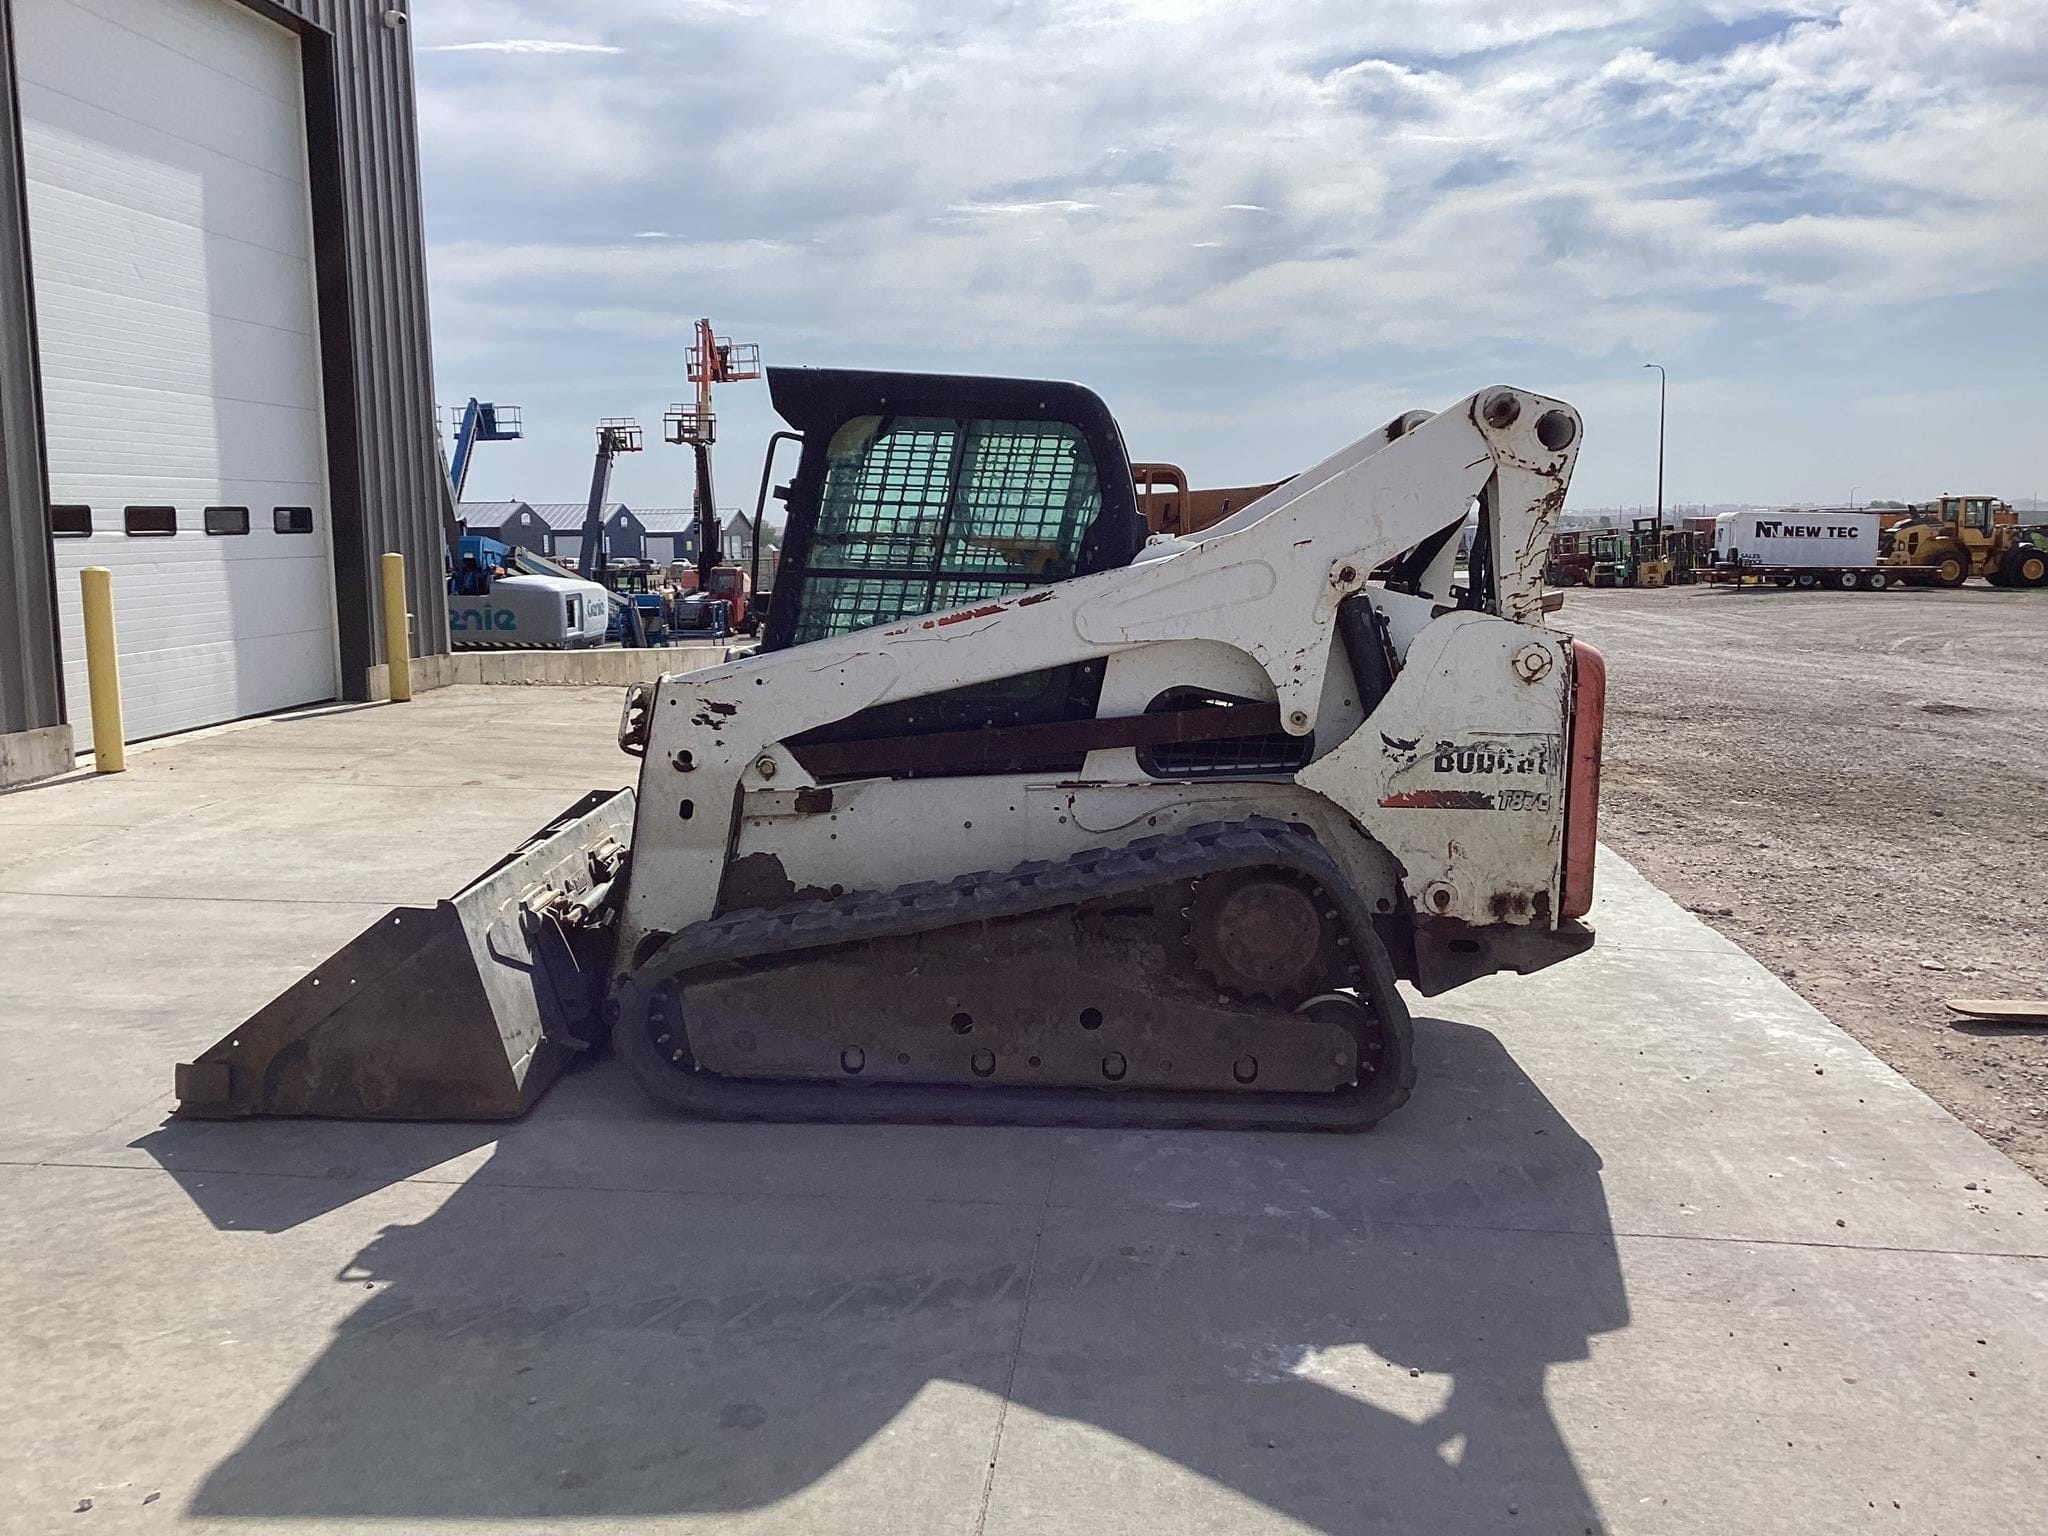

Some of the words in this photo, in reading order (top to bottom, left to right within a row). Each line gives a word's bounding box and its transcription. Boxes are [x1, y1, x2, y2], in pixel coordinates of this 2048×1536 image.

[1756, 521, 1782, 538] NT
[1783, 526, 1822, 538] NEW
[1827, 526, 1858, 538] TEC
[449, 604, 516, 631] enie
